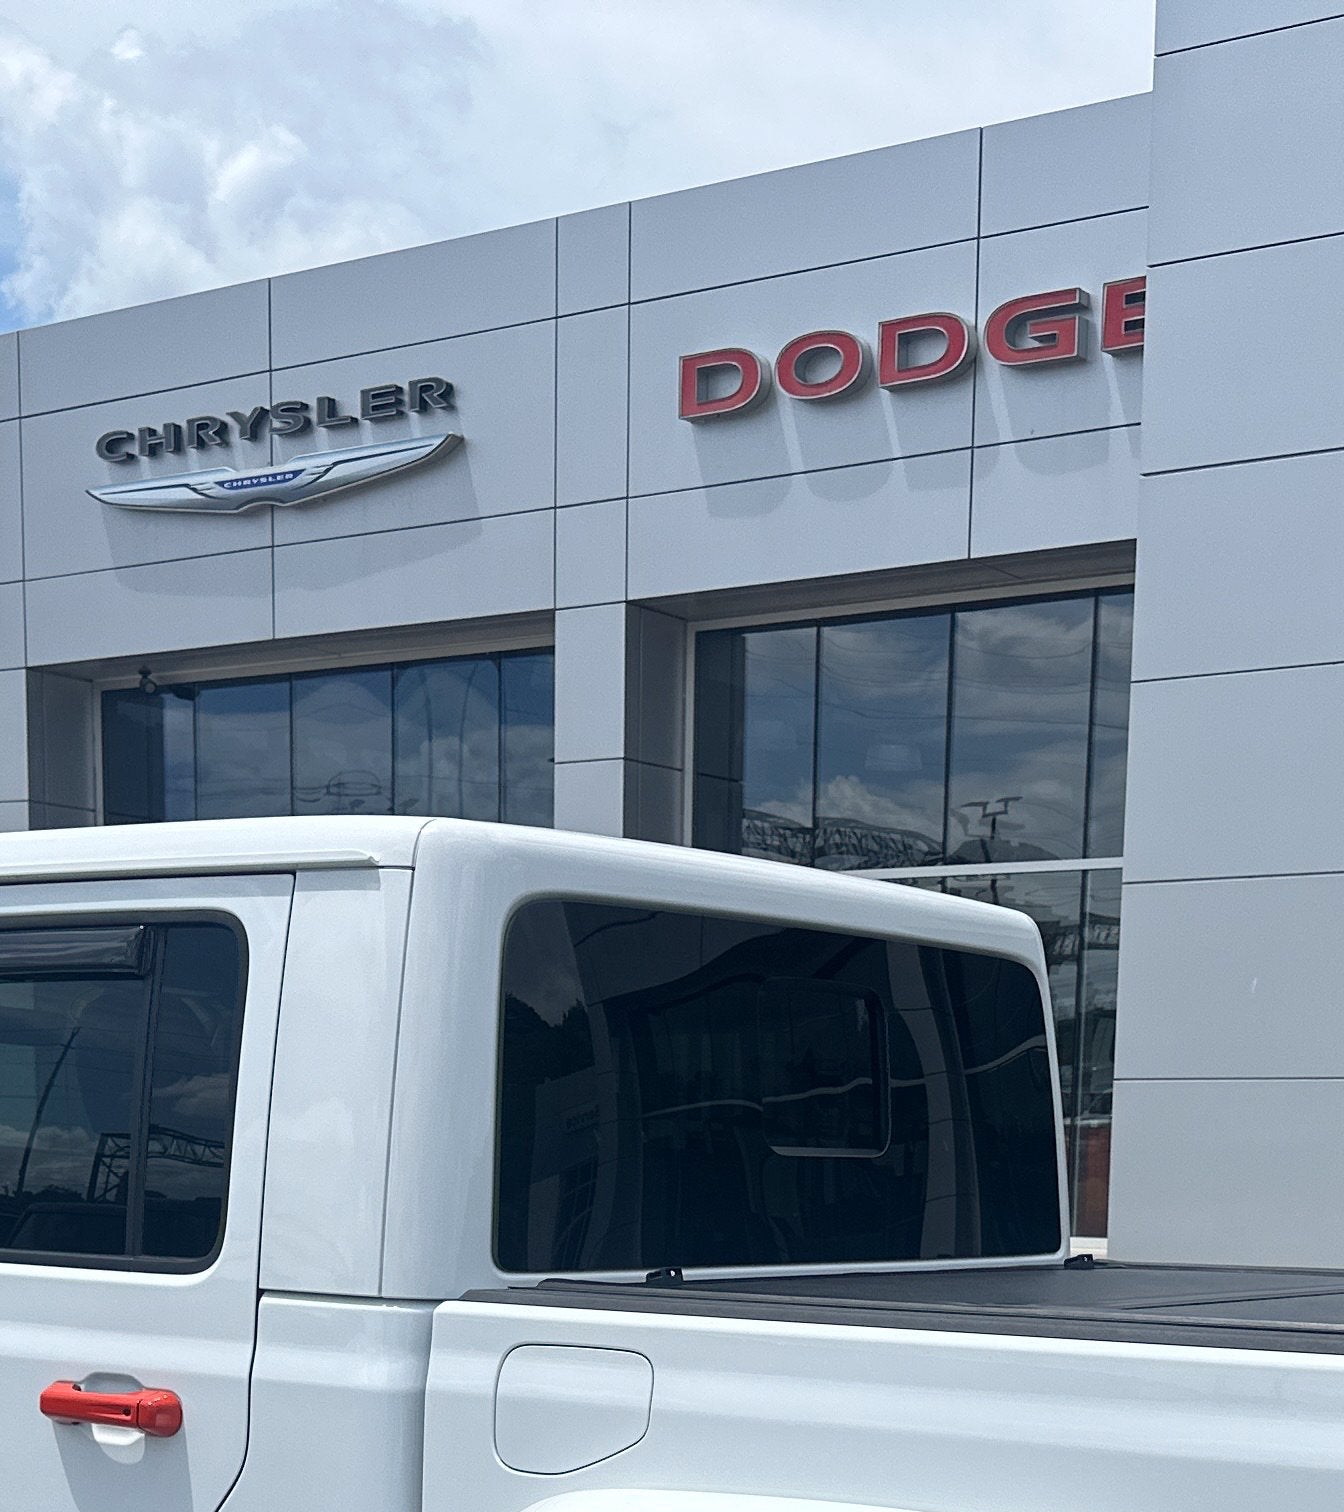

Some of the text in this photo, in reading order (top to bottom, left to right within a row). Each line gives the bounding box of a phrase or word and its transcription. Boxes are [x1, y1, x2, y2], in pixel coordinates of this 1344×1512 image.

[678, 275, 1147, 422] DODGE
[95, 376, 456, 462] CHRYSLER
[222, 471, 294, 490] CHRYSLER
